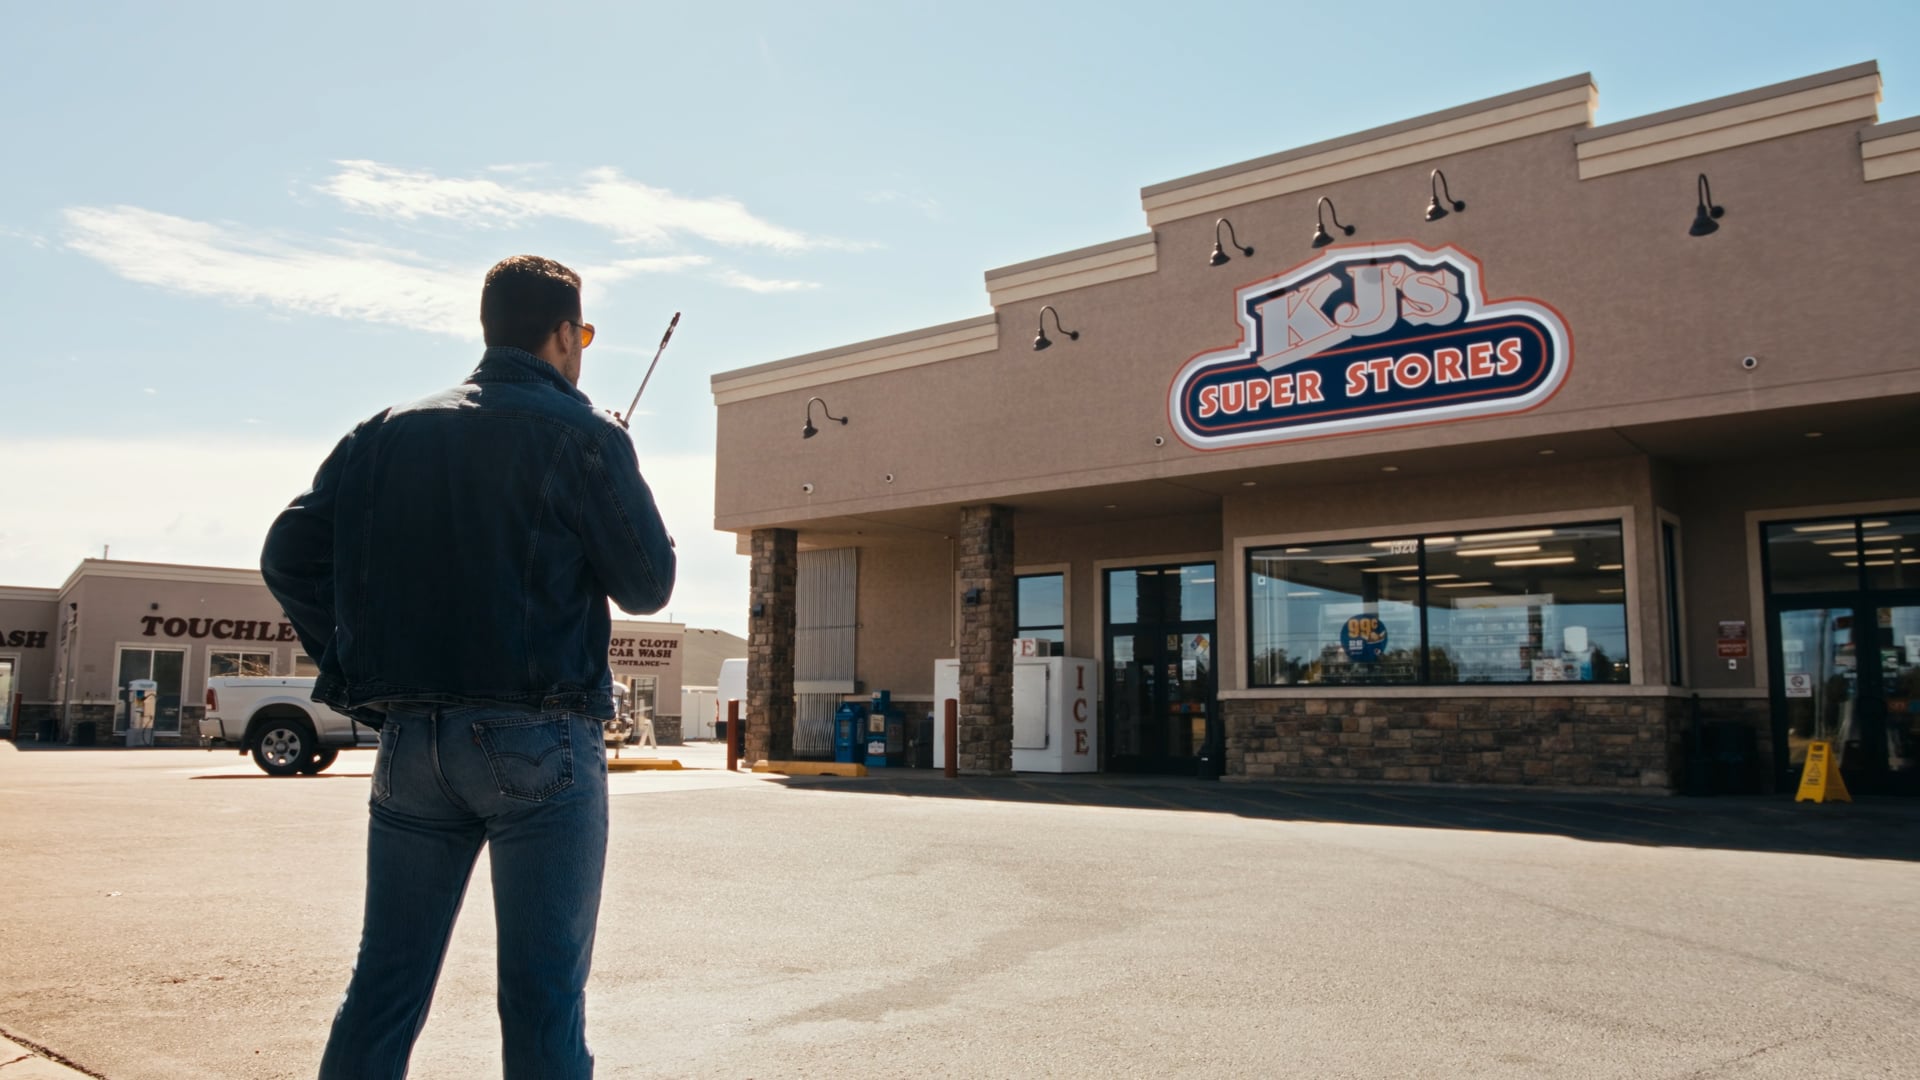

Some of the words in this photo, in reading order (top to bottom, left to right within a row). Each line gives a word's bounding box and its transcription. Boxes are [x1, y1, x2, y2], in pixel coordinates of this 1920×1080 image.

[1197, 370, 1325, 418] SUPER
[1345, 337, 1522, 398] STORES
[141, 615, 303, 642] TOUCHLE
[609, 648, 634, 657] CAR
[638, 649, 672, 658] WASH
[610, 638, 635, 647] OFT
[639, 638, 678, 649] CLOTH
[1073, 665, 1089, 755] ICE
